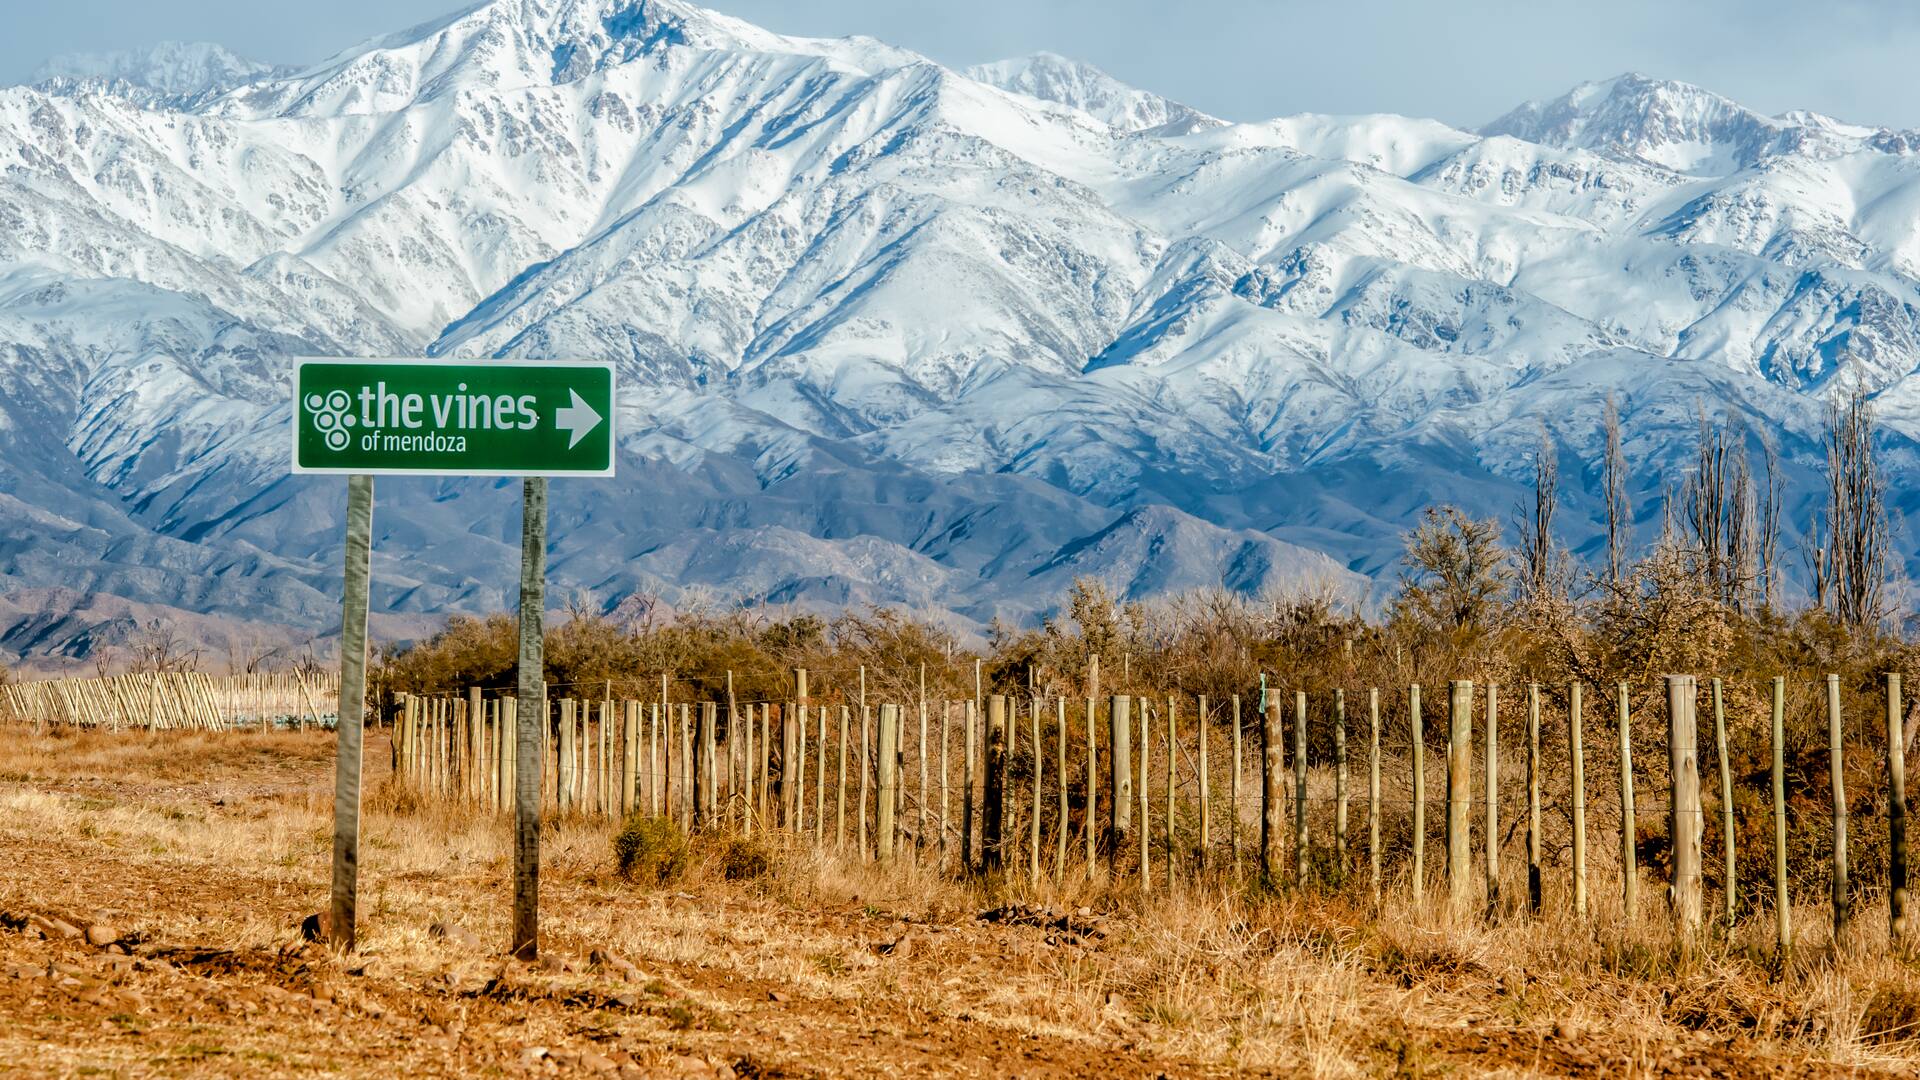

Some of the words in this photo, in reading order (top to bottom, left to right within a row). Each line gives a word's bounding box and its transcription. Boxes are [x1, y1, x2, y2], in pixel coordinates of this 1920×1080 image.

[358, 381, 424, 428] the
[430, 382, 538, 430] vines
[361, 430, 380, 451] of
[384, 431, 466, 452] mendoza
